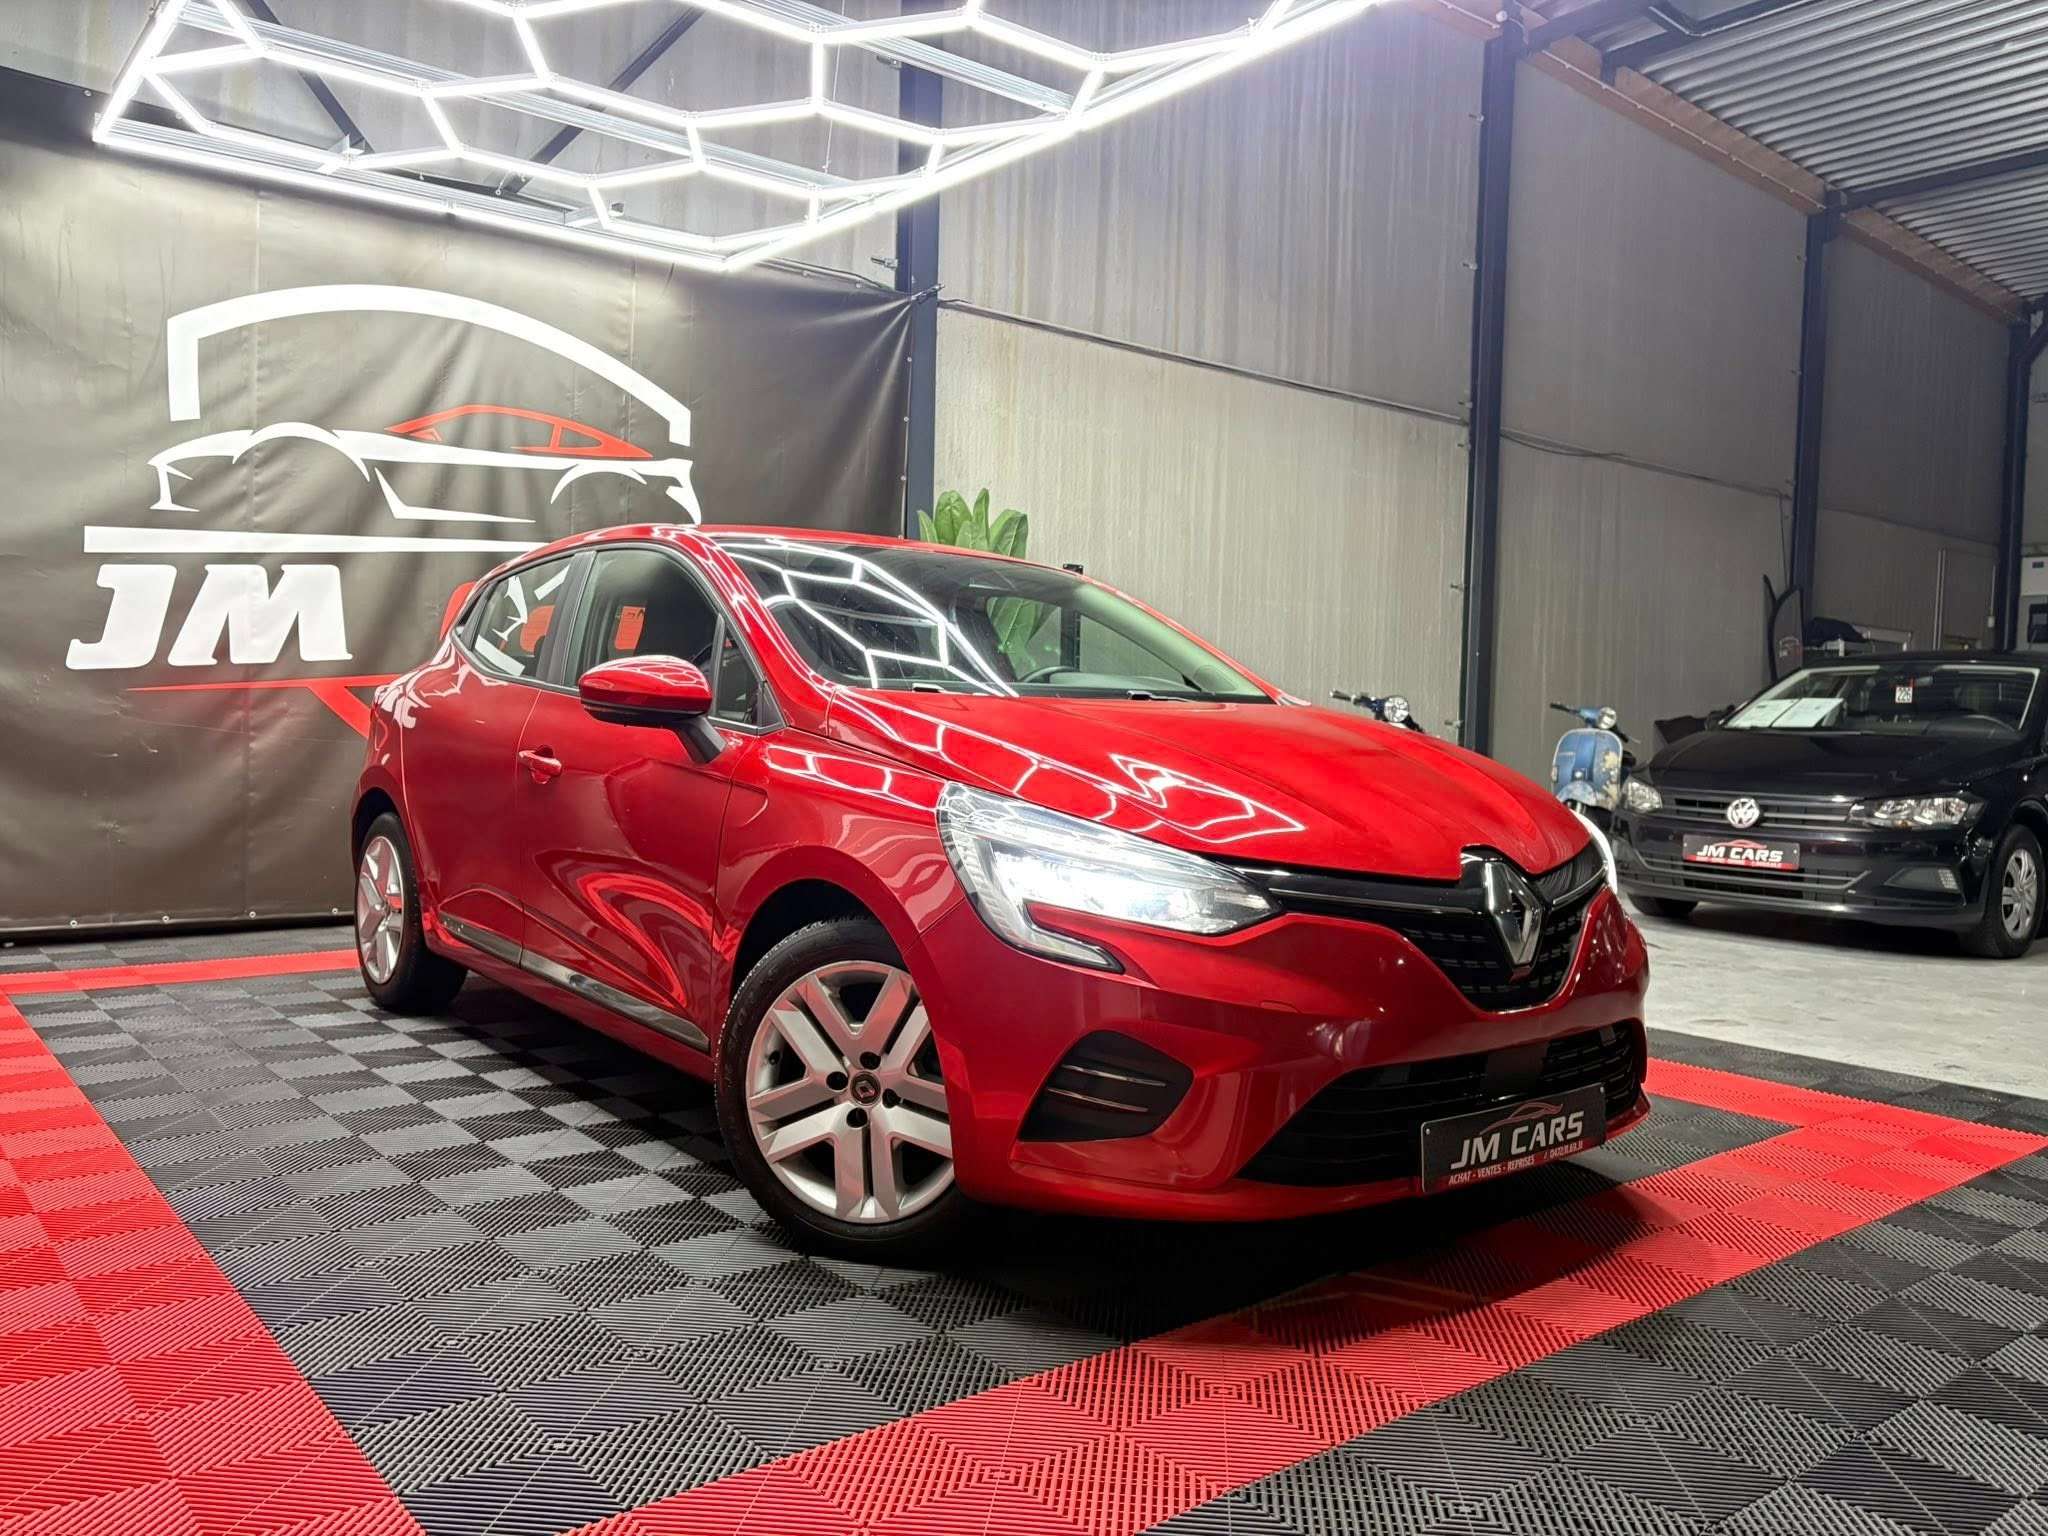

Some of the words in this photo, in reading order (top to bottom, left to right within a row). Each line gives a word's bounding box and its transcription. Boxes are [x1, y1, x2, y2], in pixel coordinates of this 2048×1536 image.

[65, 563, 353, 670] JM
[1696, 844, 1726, 858] JM
[1729, 847, 1784, 863] CARS
[1450, 1132, 1501, 1169] JM
[1510, 1110, 1585, 1155] CARS
[1448, 1170, 1473, 1186] ACHAT
[1477, 1163, 1502, 1179] VENTES
[1507, 1155, 1536, 1171] REPRISES
